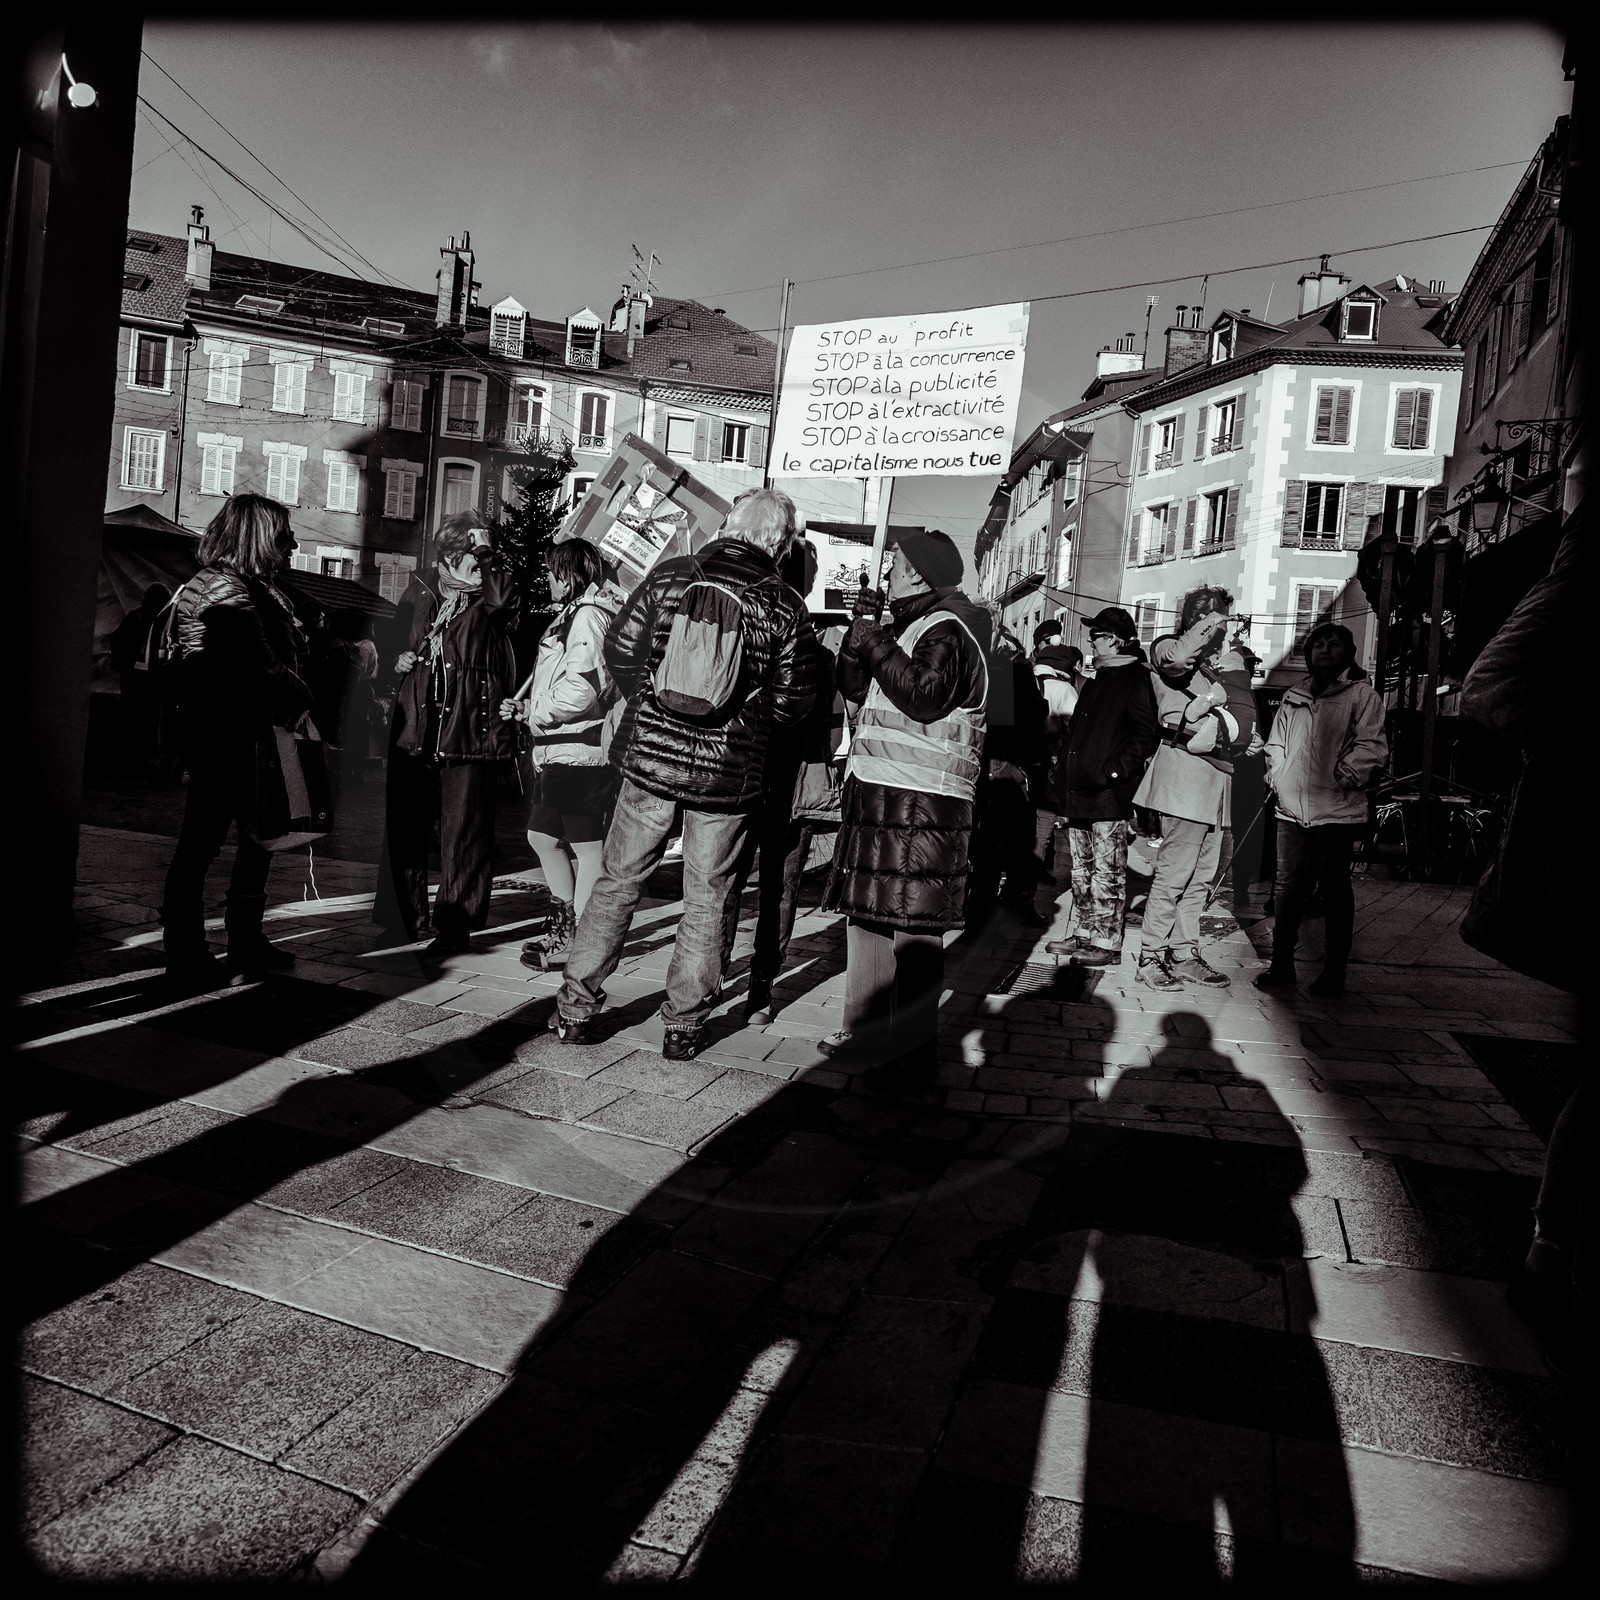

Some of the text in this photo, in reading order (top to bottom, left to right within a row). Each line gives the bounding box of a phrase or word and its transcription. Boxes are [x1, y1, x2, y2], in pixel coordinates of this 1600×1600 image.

[818, 322, 973, 348] STOP au profit
[815, 348, 1015, 372] STOP à la concurrence
[810, 376, 869, 397] STOP
[909, 370, 998, 400] publicité
[807, 395, 1005, 422] STOP à l'extractivité
[801, 426, 861, 446] STOP
[865, 427, 878, 445] à
[782, 452, 1001, 474] le capitalisme nous tue
[629, 543, 649, 561] FUTUR
